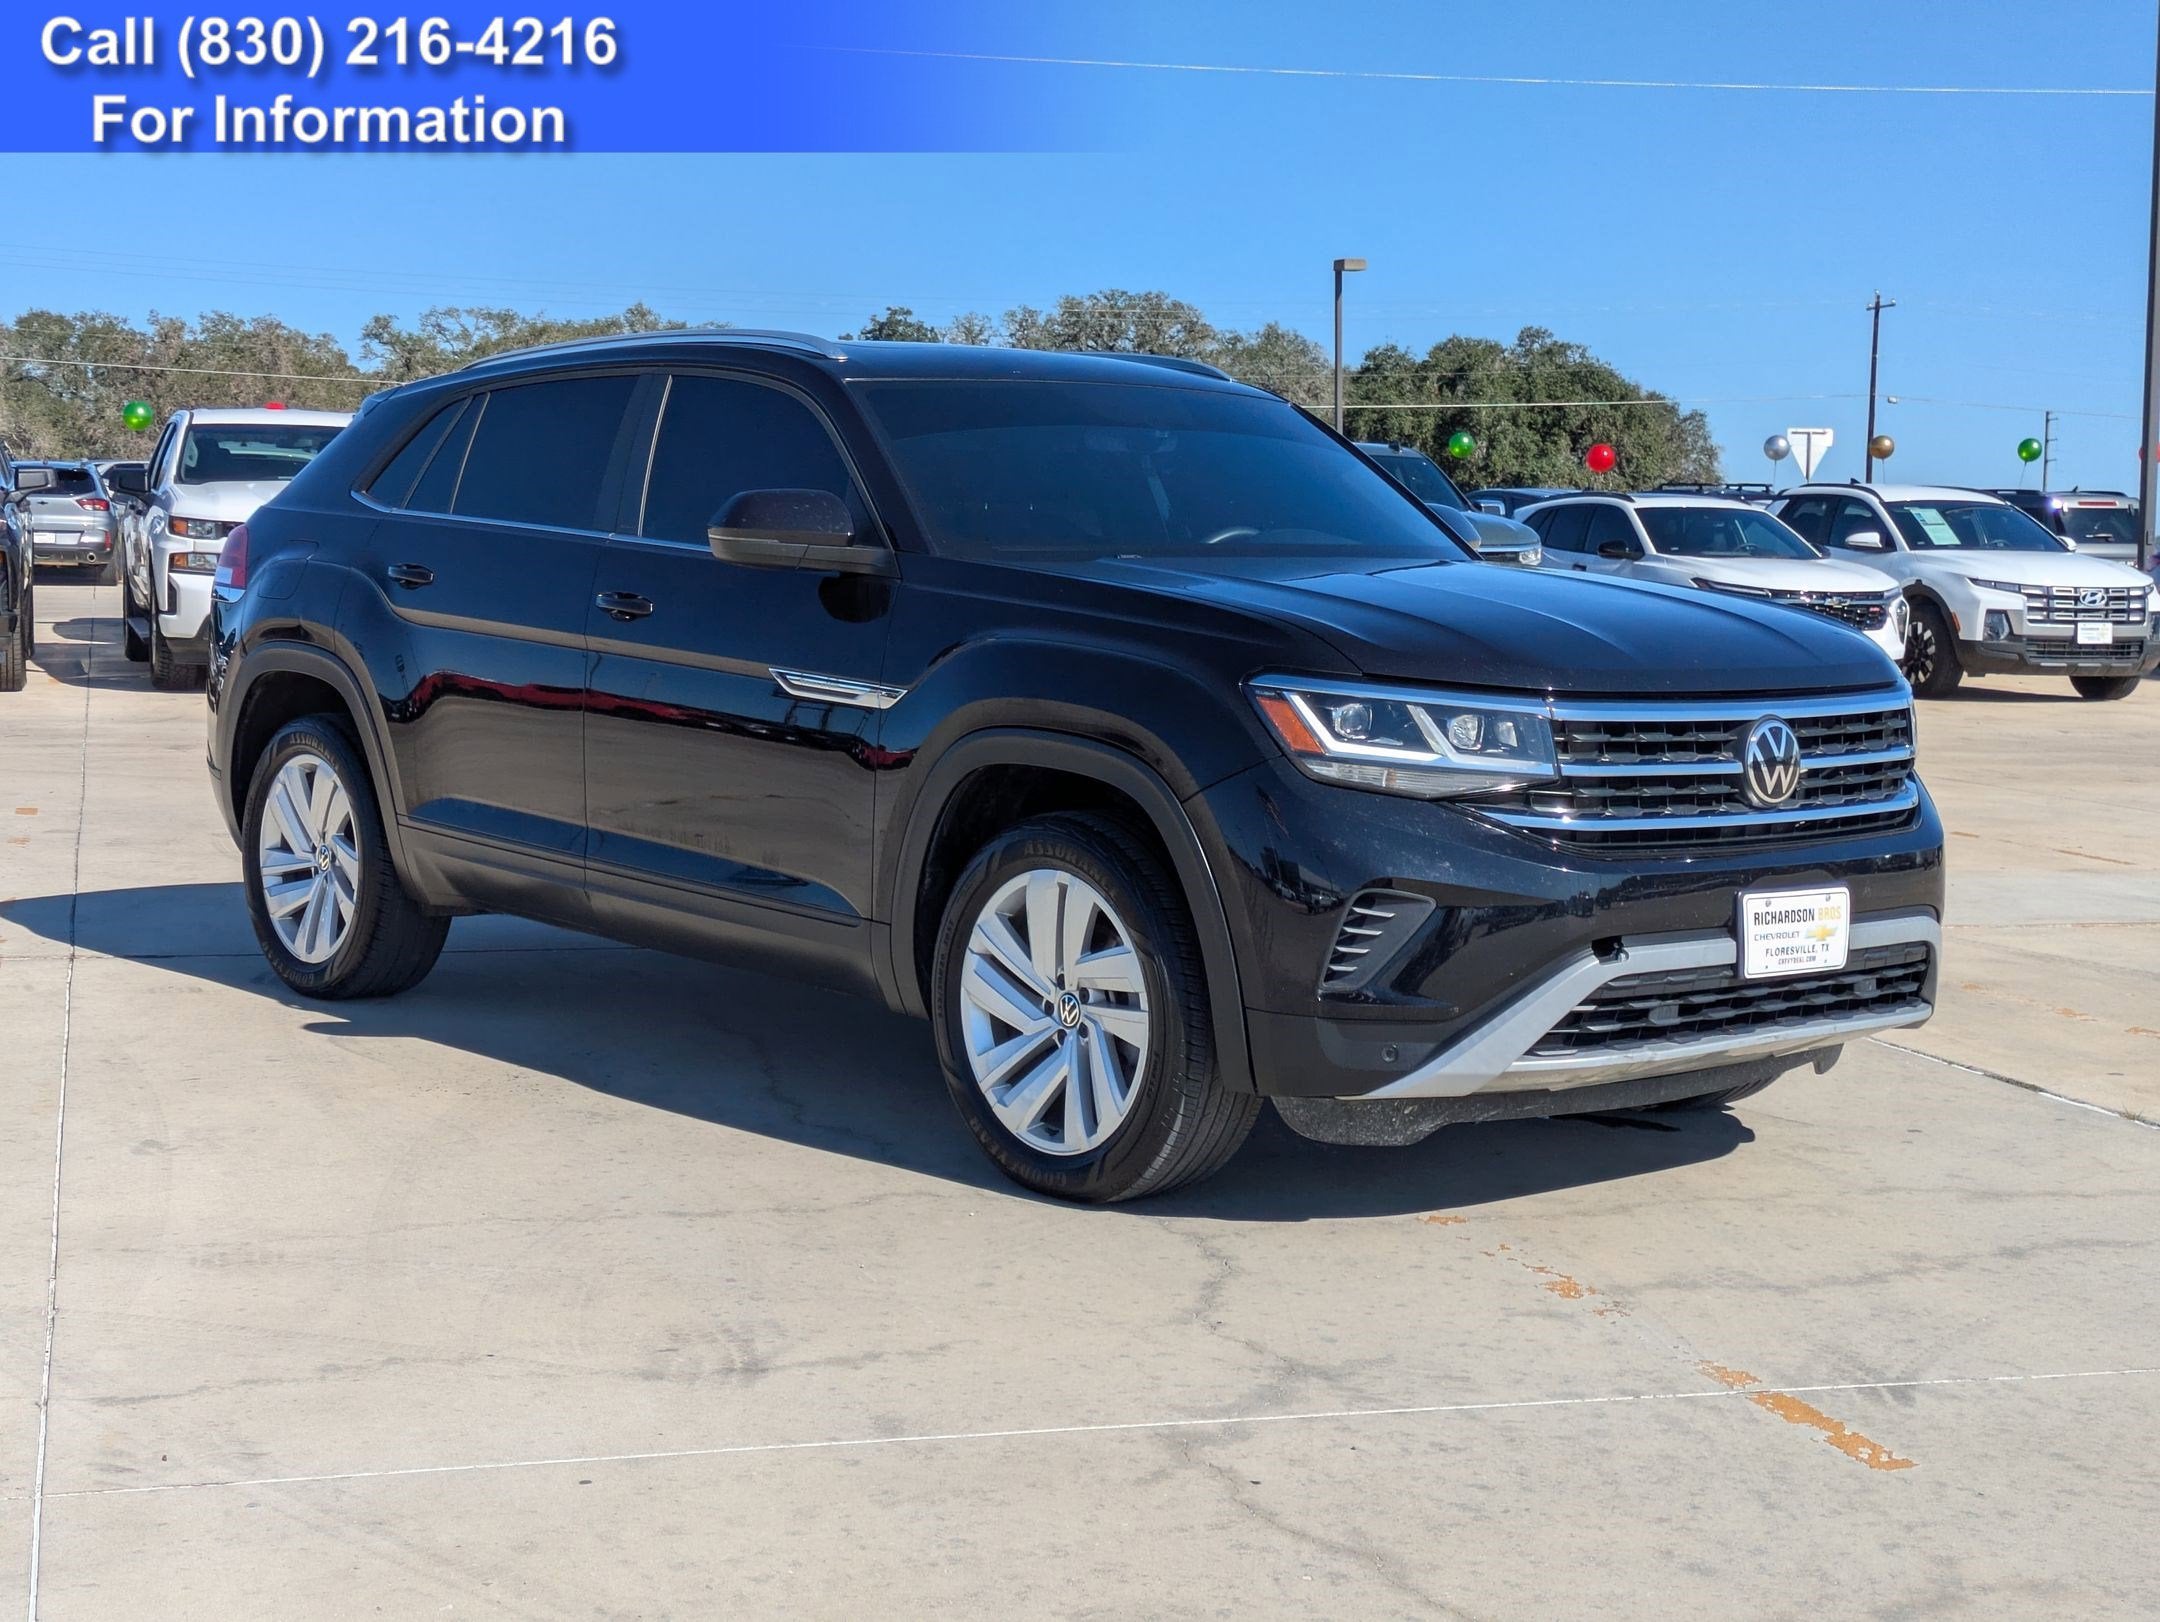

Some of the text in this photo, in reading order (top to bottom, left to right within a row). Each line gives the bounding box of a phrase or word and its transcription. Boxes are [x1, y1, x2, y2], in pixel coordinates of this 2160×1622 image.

[1754, 905, 1842, 926] RICHARDSON BROS
[1754, 930, 1800, 942] CHEVROLET
[1765, 943, 1830, 957] FLORESVILLE, TX
